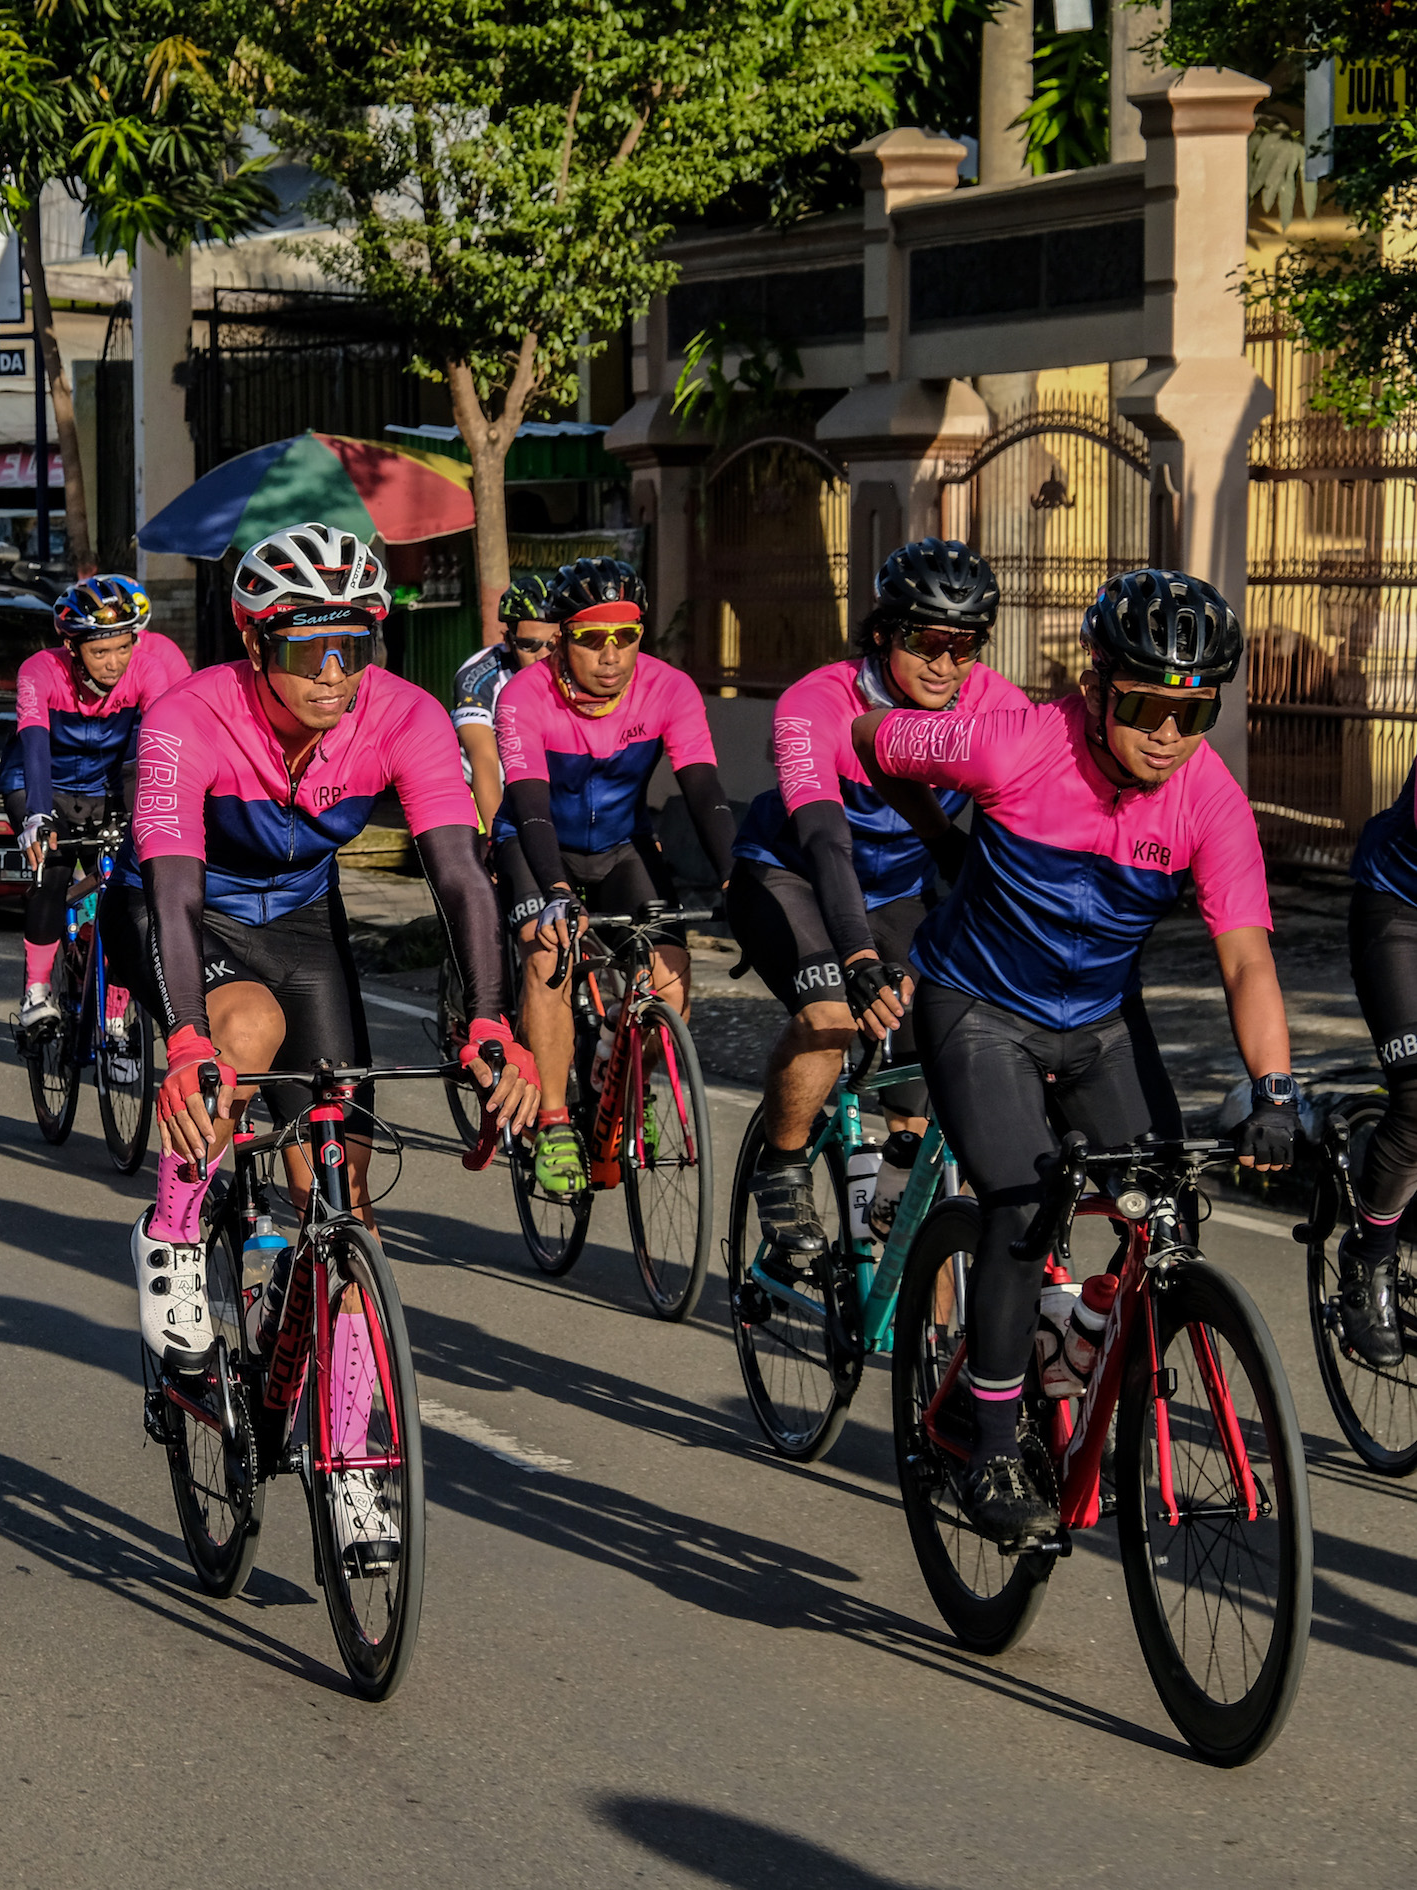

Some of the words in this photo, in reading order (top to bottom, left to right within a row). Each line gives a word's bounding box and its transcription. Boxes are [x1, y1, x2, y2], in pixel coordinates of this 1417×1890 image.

[292, 608, 352, 626] Santic
[134, 728, 183, 845] KRBK
[774, 716, 822, 802] KRBK
